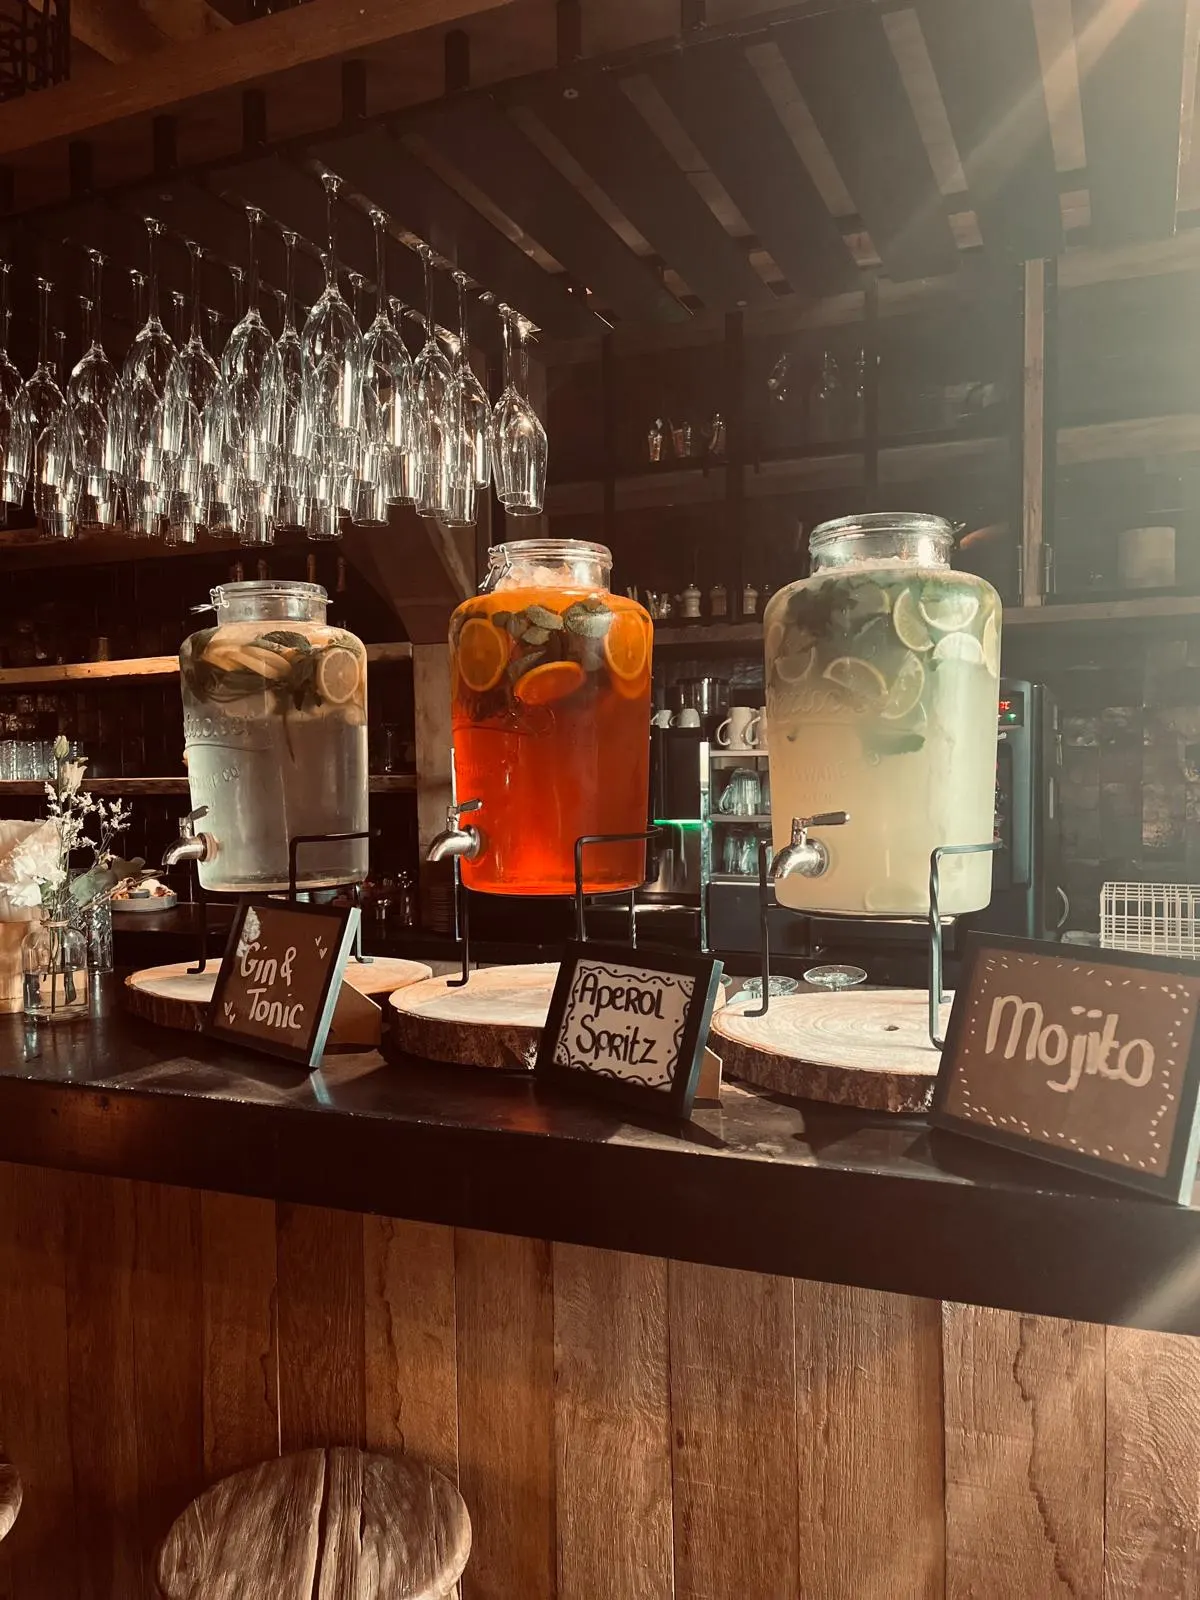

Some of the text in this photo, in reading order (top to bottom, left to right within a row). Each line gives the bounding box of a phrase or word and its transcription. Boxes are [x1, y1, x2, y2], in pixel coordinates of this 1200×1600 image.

[239, 941, 297, 987] Gin &
[246, 988, 305, 1030] Tonic
[985, 995, 1155, 1093] Mojito
